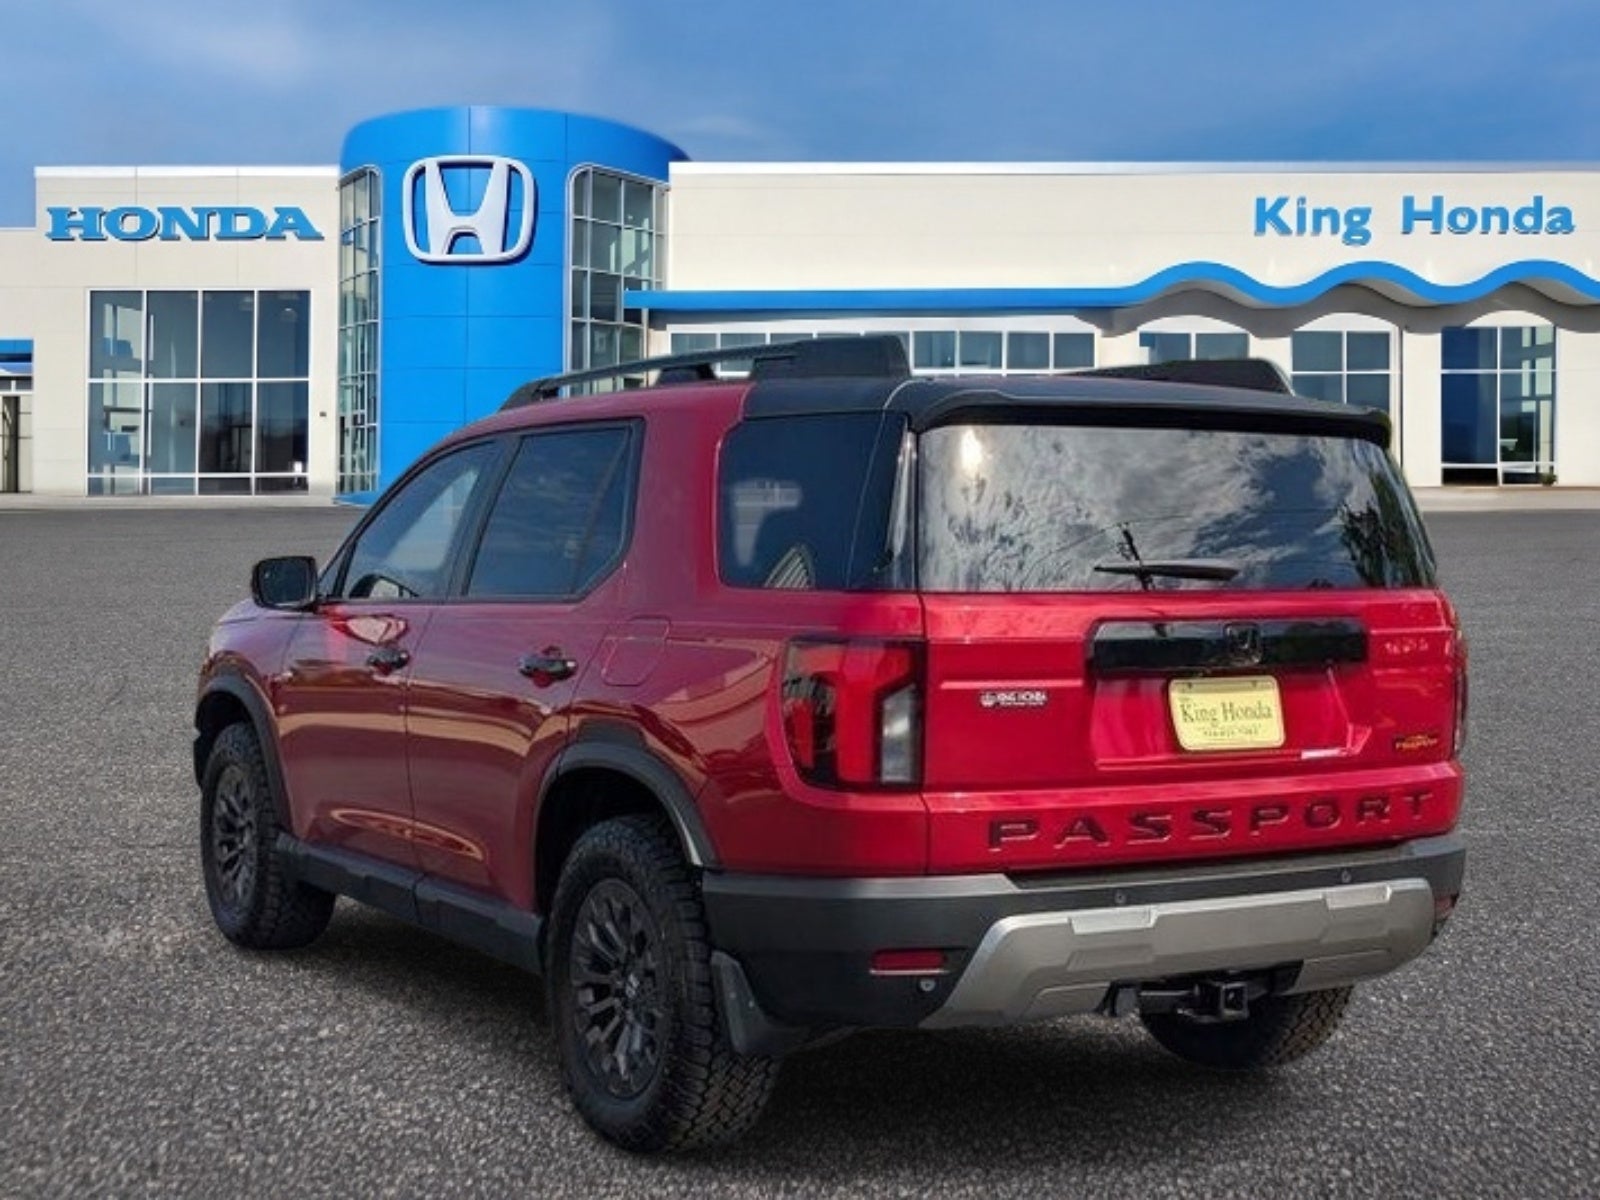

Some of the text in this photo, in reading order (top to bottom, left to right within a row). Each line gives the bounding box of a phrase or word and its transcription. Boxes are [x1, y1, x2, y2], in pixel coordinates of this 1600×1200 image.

[45, 206, 324, 241] HONDA
[1254, 195, 1575, 246] King Honda
[1180, 701, 1273, 724] King Honda
[988, 793, 1433, 852] PASSPORT
